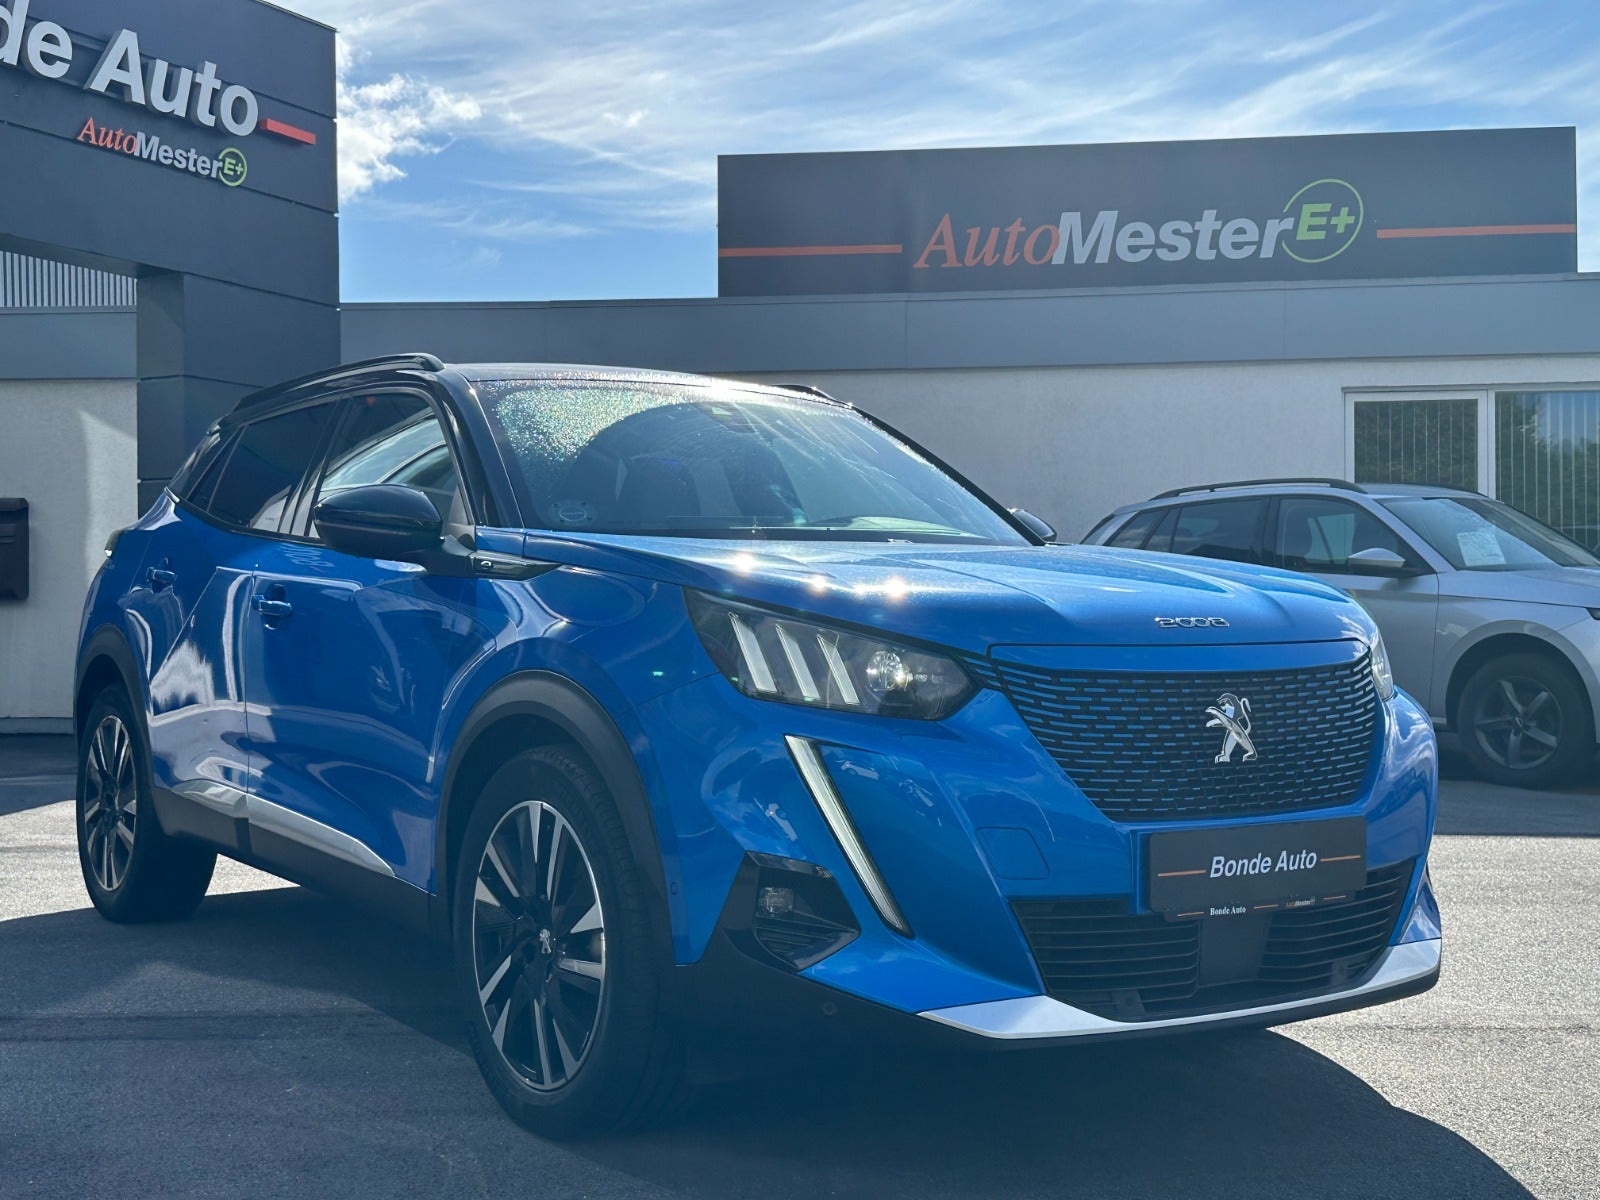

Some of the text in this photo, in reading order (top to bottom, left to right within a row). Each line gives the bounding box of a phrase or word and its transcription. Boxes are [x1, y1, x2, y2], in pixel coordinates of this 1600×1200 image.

[86, 28, 259, 137] Auto
[77, 116, 223, 178] AutoMester
[913, 209, 1293, 269] AutoMester
[1210, 849, 1318, 878] Bonde Auto
